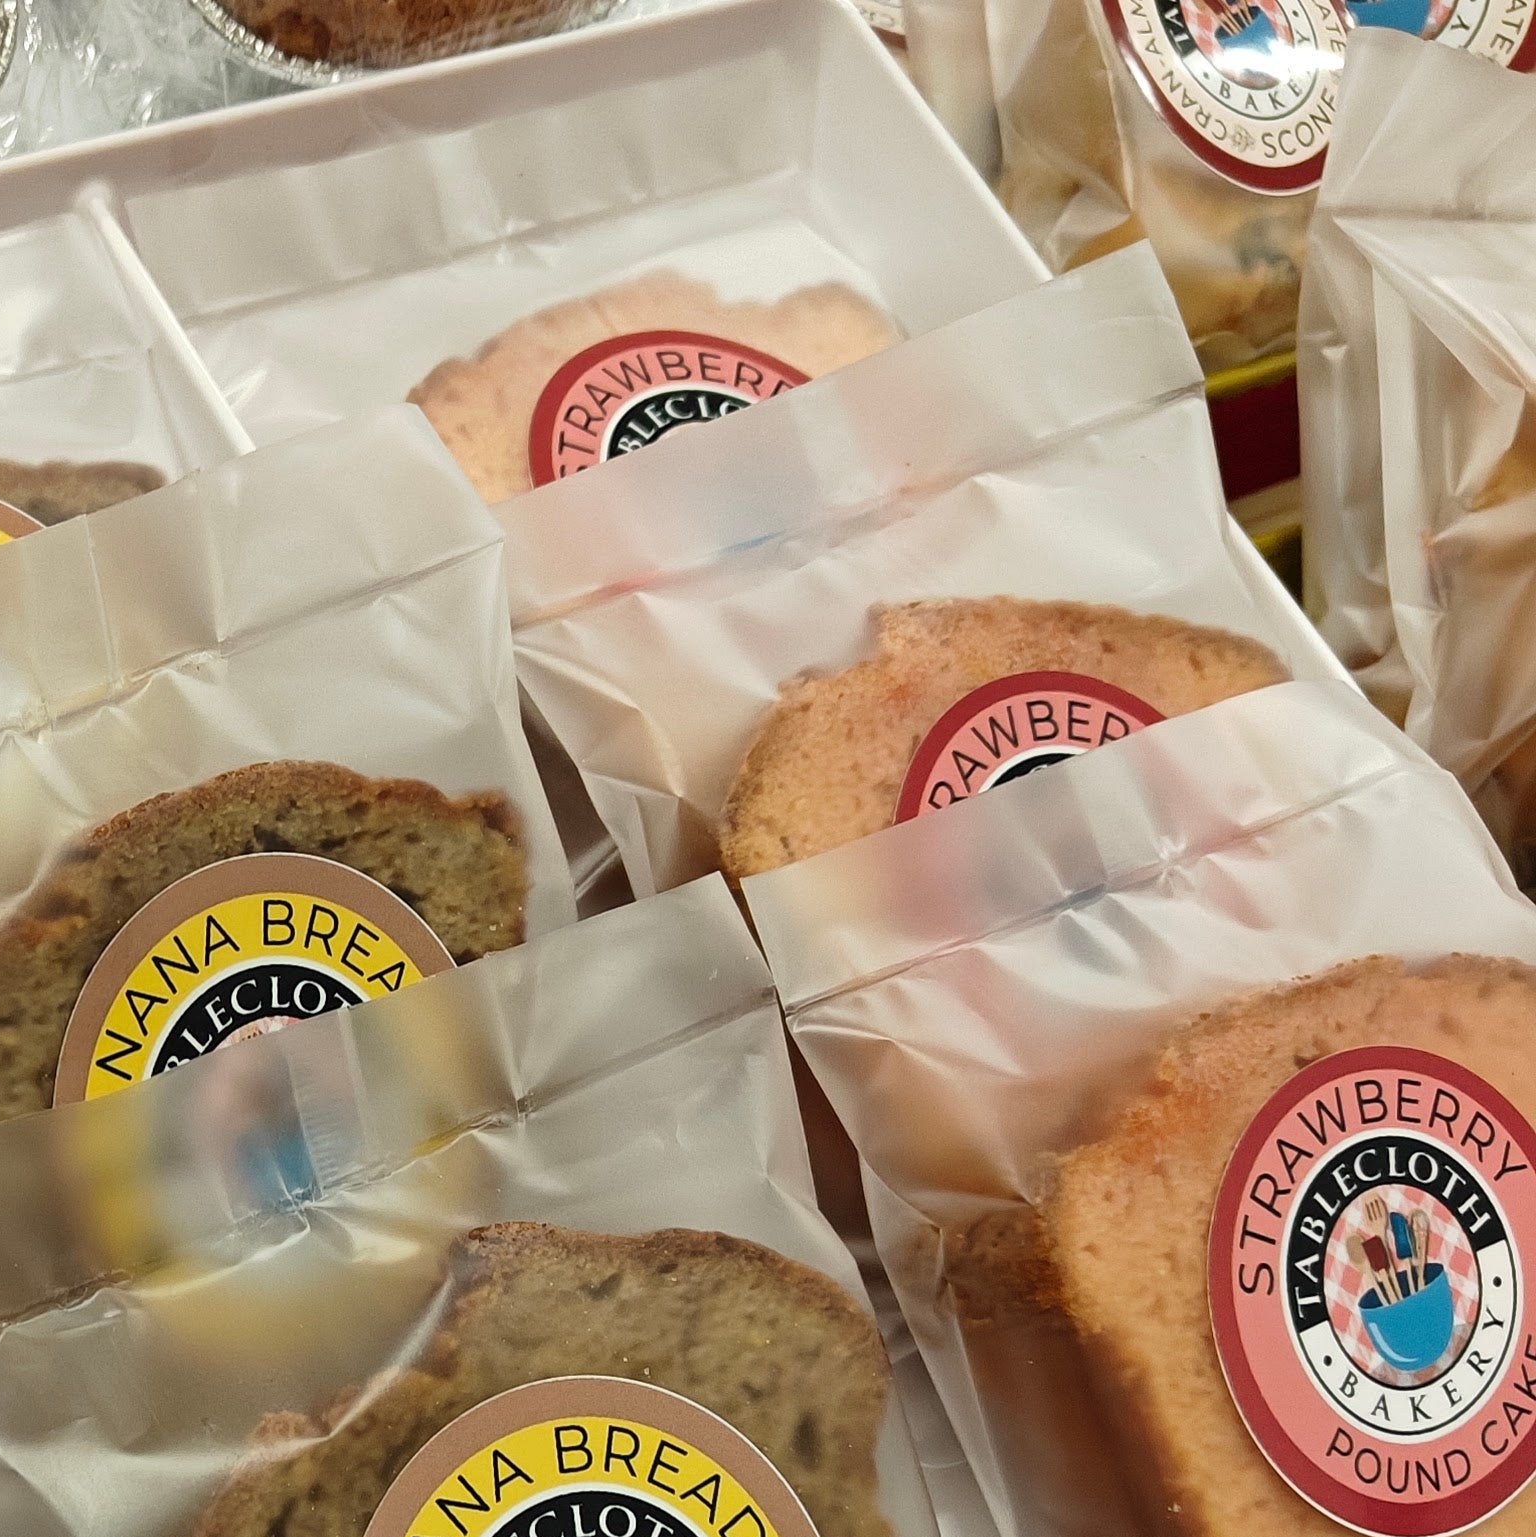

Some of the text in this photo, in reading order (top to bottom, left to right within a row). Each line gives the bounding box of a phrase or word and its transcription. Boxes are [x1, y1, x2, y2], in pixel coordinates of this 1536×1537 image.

[1219, 29, 1311, 112] BAKEY
[558, 351, 794, 479] TRAWBER
[96, 914, 240, 1080] NANA
[1238, 1078, 1528, 1296] STRAWBERRY
[1294, 1146, 1492, 1319] TABLECLOTH
[1339, 1305, 1505, 1423] BAKERY
[1326, 1427, 1471, 1495] POUND
